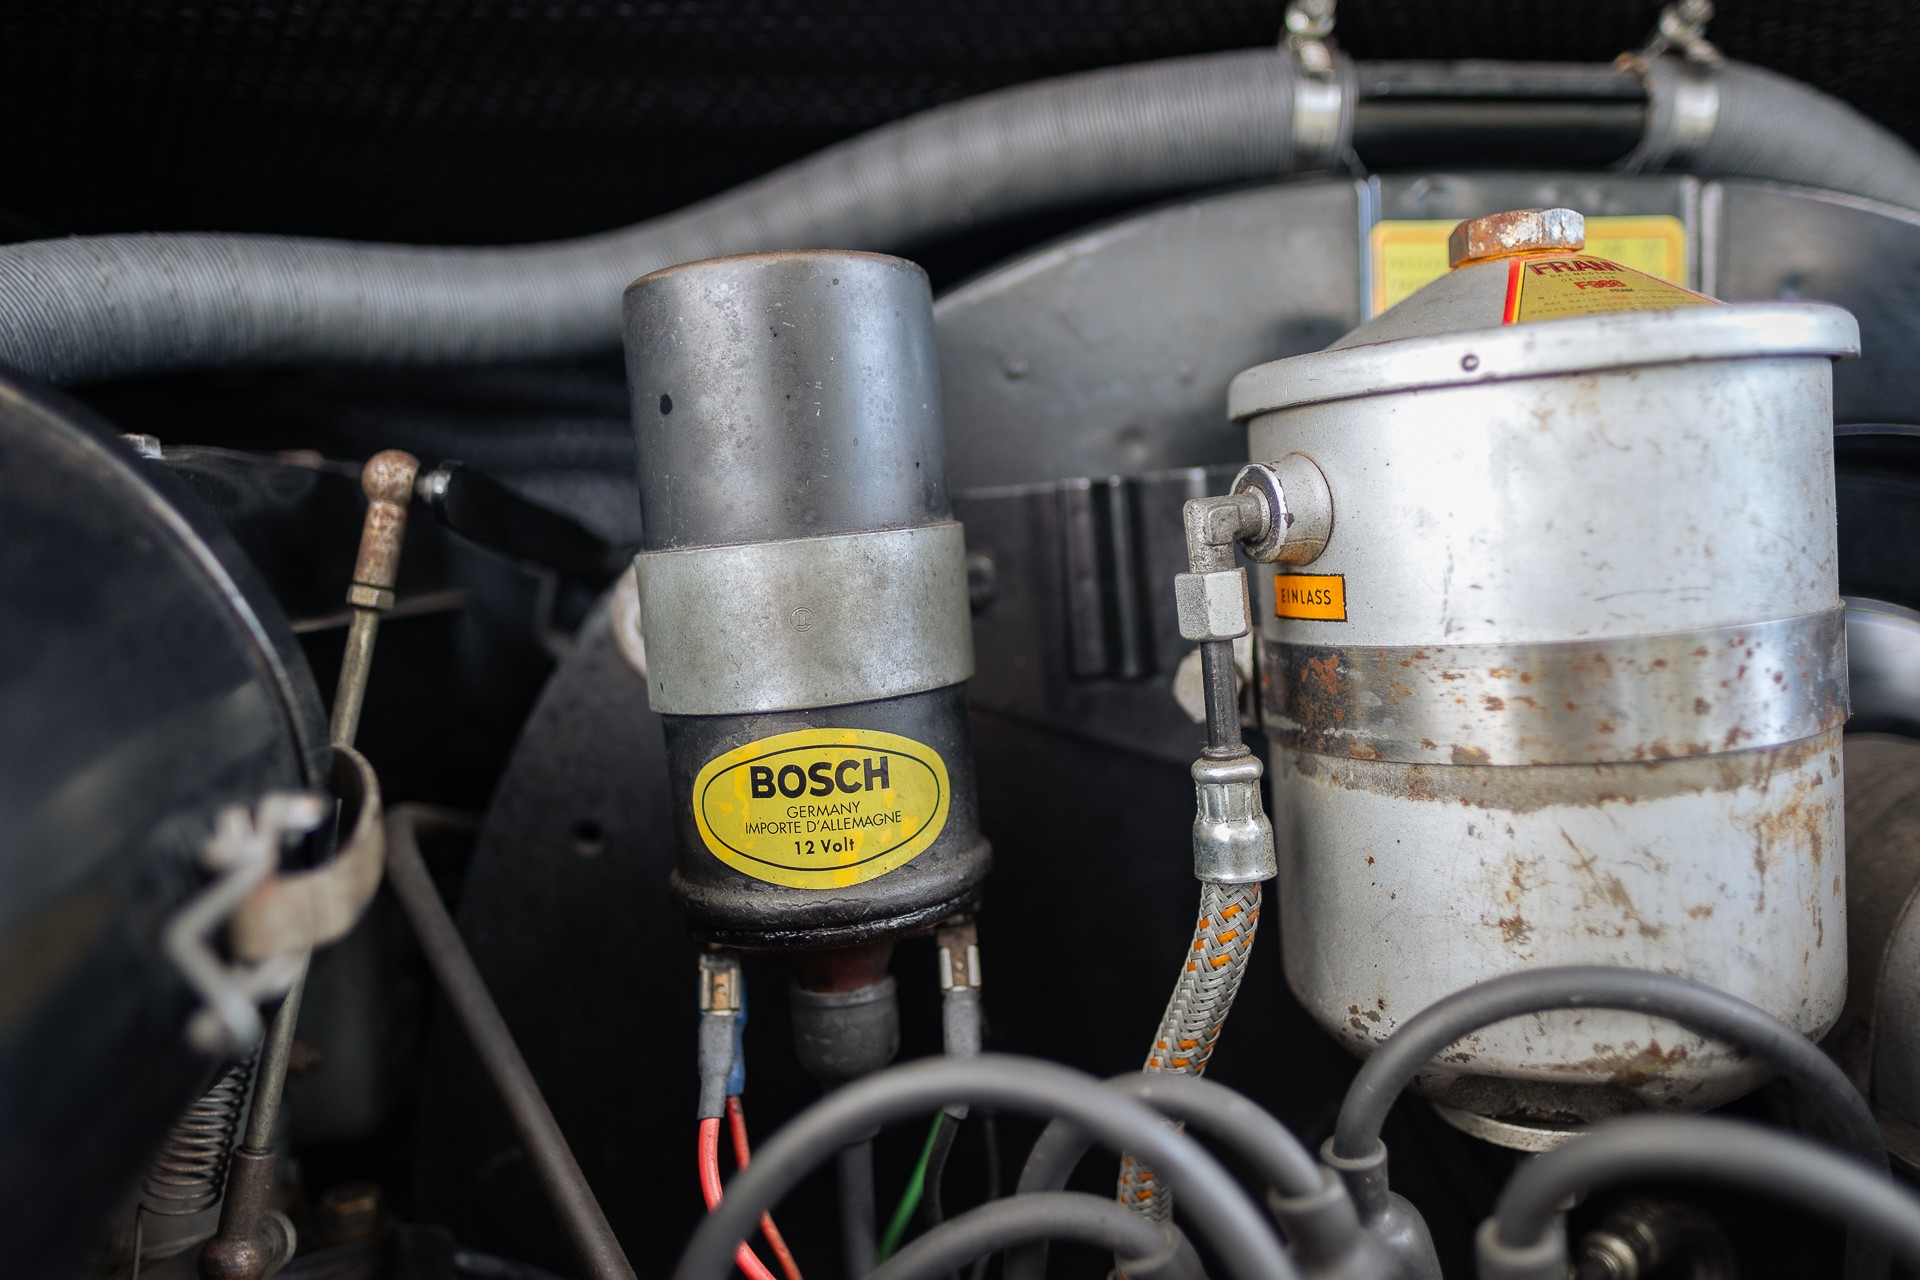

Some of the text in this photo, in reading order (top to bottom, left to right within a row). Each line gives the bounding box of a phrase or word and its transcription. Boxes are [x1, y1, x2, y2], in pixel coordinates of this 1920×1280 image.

[1527, 260, 1624, 276] FRAM
[1281, 588, 1332, 605] EINLASS
[749, 756, 890, 799] BOSCH
[786, 801, 861, 819] GERMANY
[745, 811, 903, 835] IMPORTE D'ALLEMAGNE
[794, 836, 855, 855] 12 Volt
